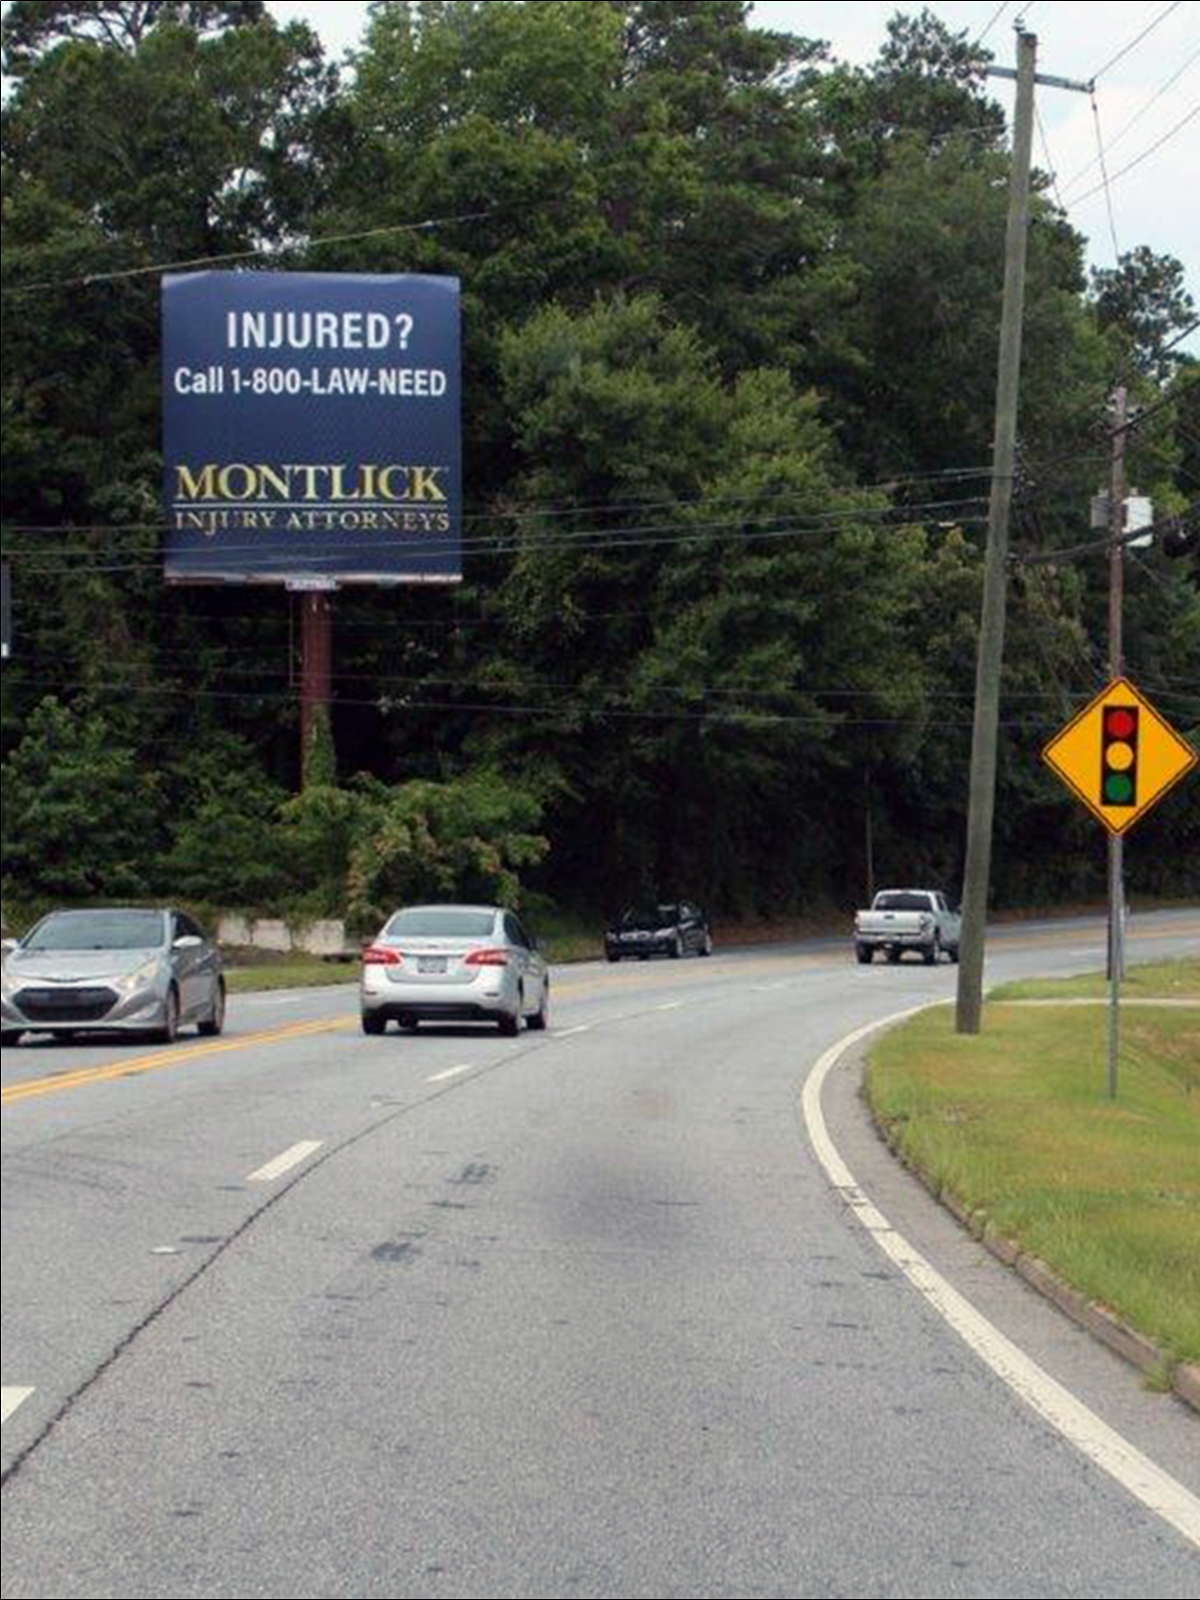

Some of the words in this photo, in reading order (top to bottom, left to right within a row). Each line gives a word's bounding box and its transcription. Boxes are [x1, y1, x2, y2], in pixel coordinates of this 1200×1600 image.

[227, 311, 414, 350] INJURED?
[173, 366, 224, 394] Call
[231, 367, 447, 396] 1-800-LAW-NEED
[174, 463, 448, 501] MONTLICK
[175, 511, 276, 536] INJURY
[285, 511, 450, 532] ATTORNEYS
